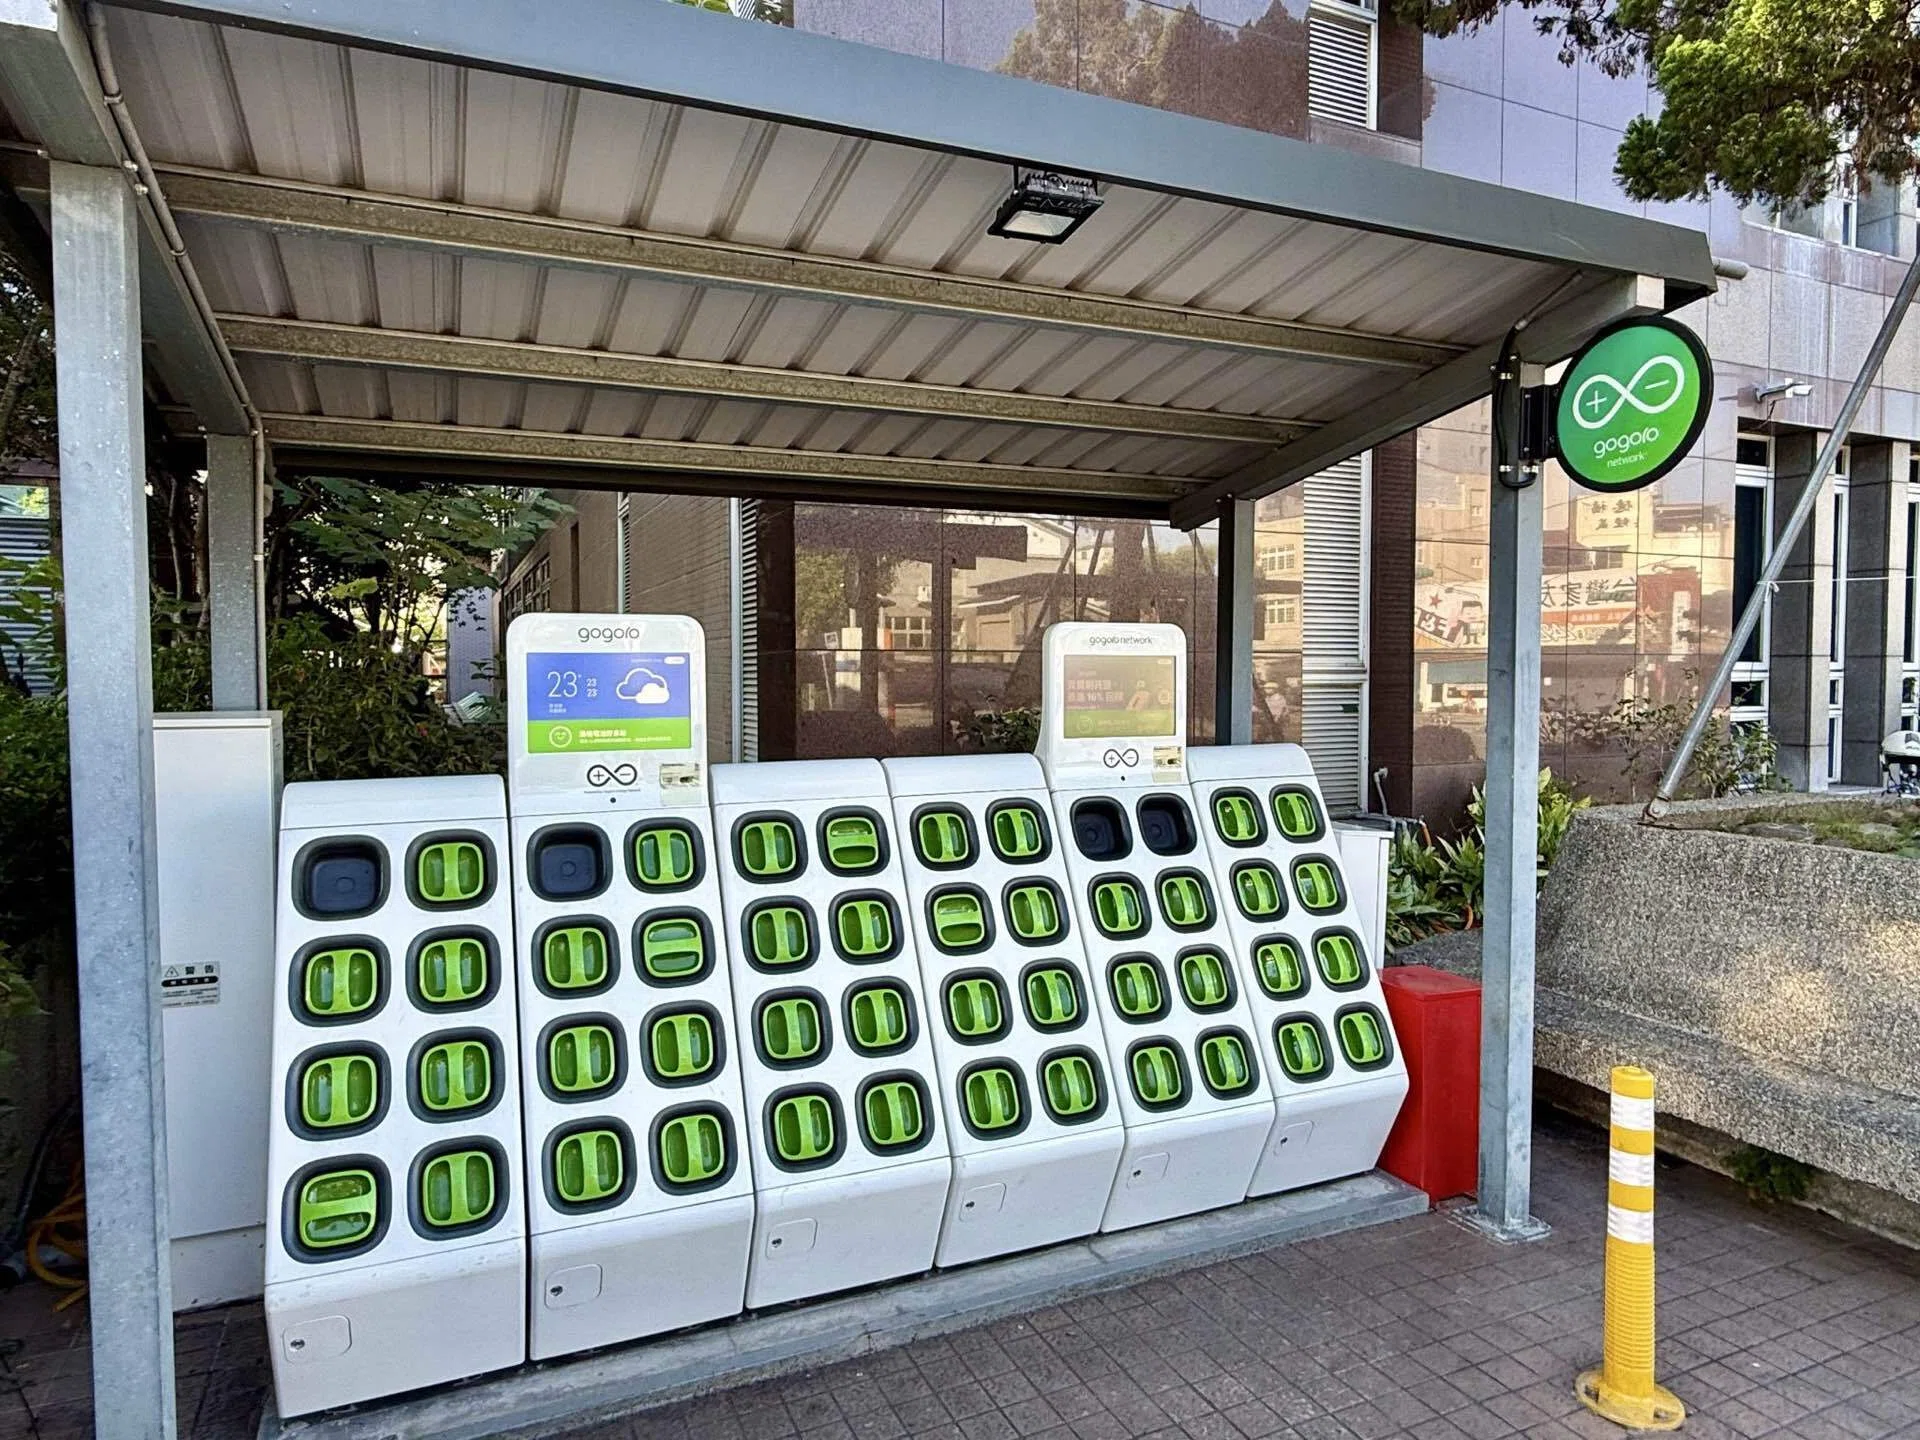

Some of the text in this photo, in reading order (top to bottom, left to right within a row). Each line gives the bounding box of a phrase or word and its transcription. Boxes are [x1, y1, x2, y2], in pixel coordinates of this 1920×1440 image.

[1594, 427, 1660, 459] gogoro
[1607, 451, 1646, 468] network
[578, 626, 640, 643] gogoro
[1089, 635, 1153, 647] gogoro network
